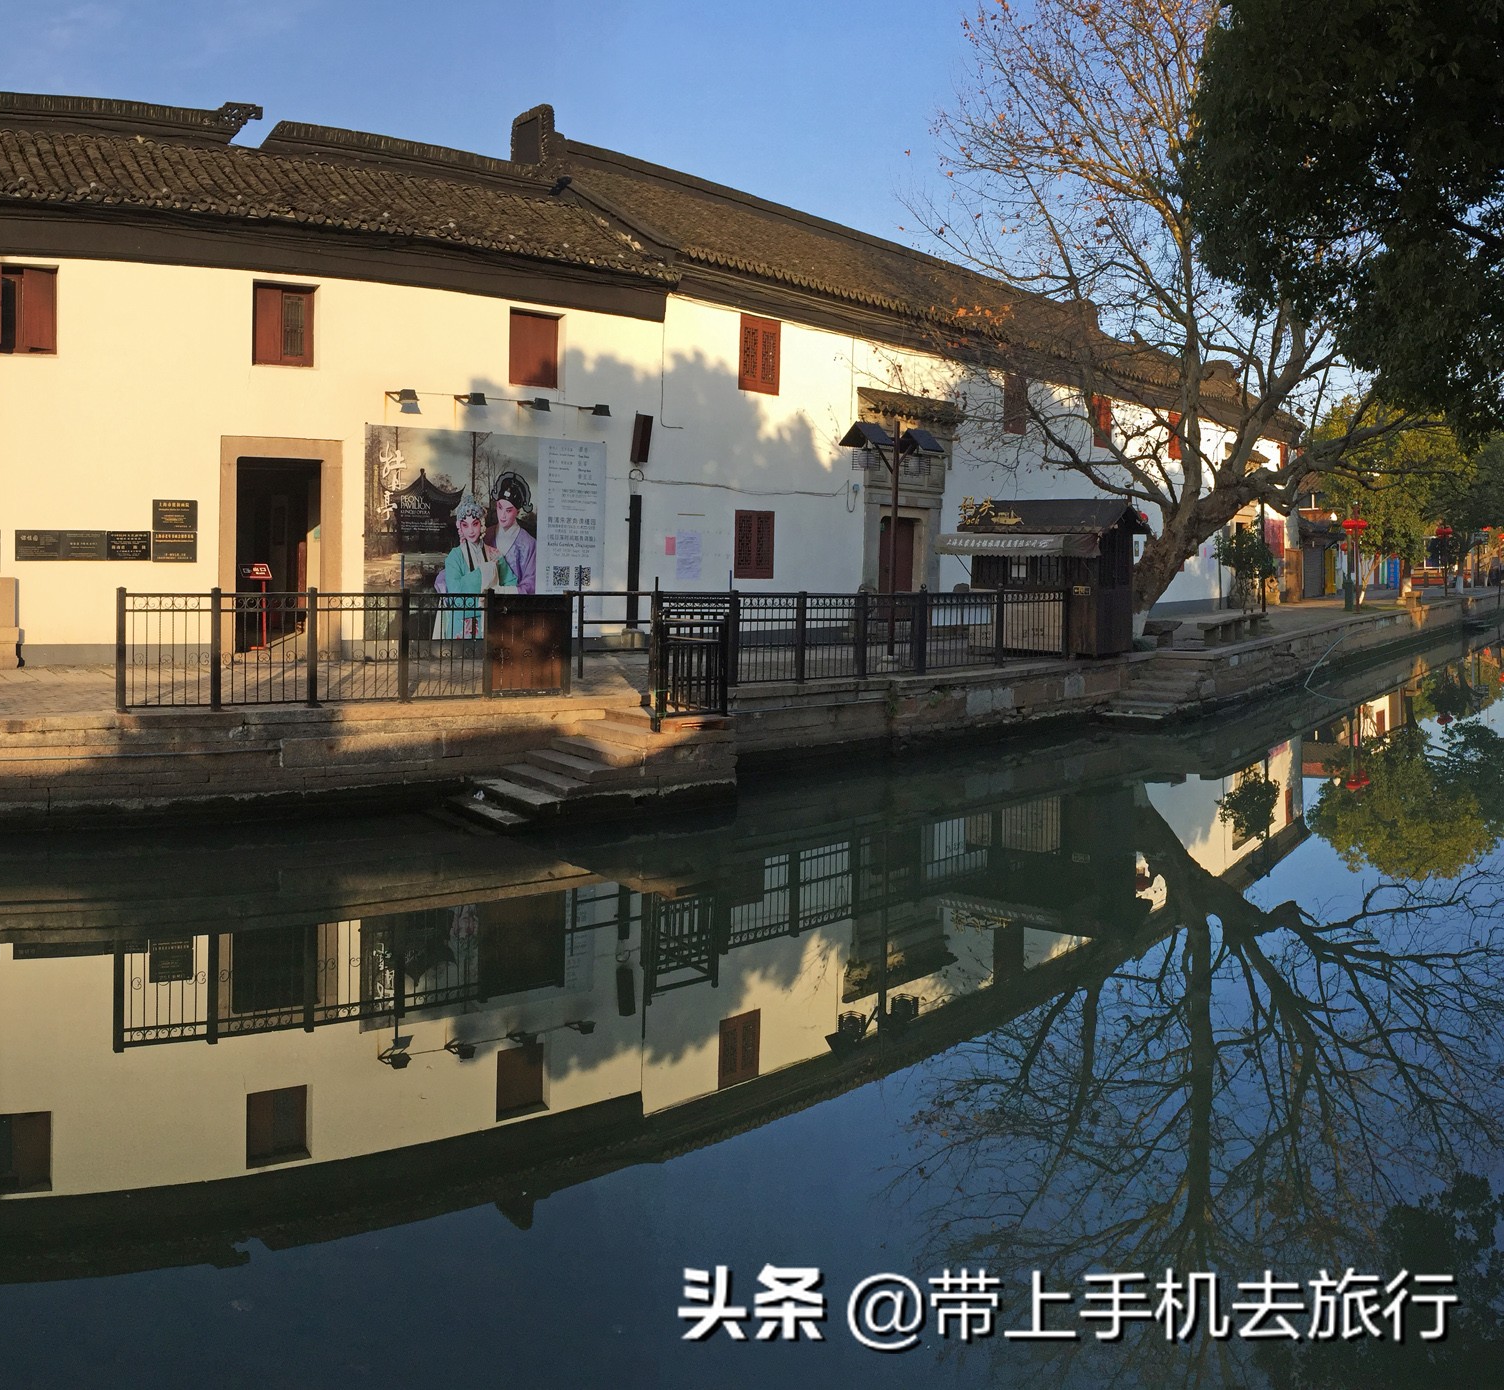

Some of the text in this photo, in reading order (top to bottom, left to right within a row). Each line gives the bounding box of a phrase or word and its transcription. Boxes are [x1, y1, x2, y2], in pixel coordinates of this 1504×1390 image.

[377, 441, 406, 520] 牡丹亭
[400, 495, 424, 503] PEONY
[400, 502, 431, 510] PAVILION
[958, 496, 995, 516] 码头
